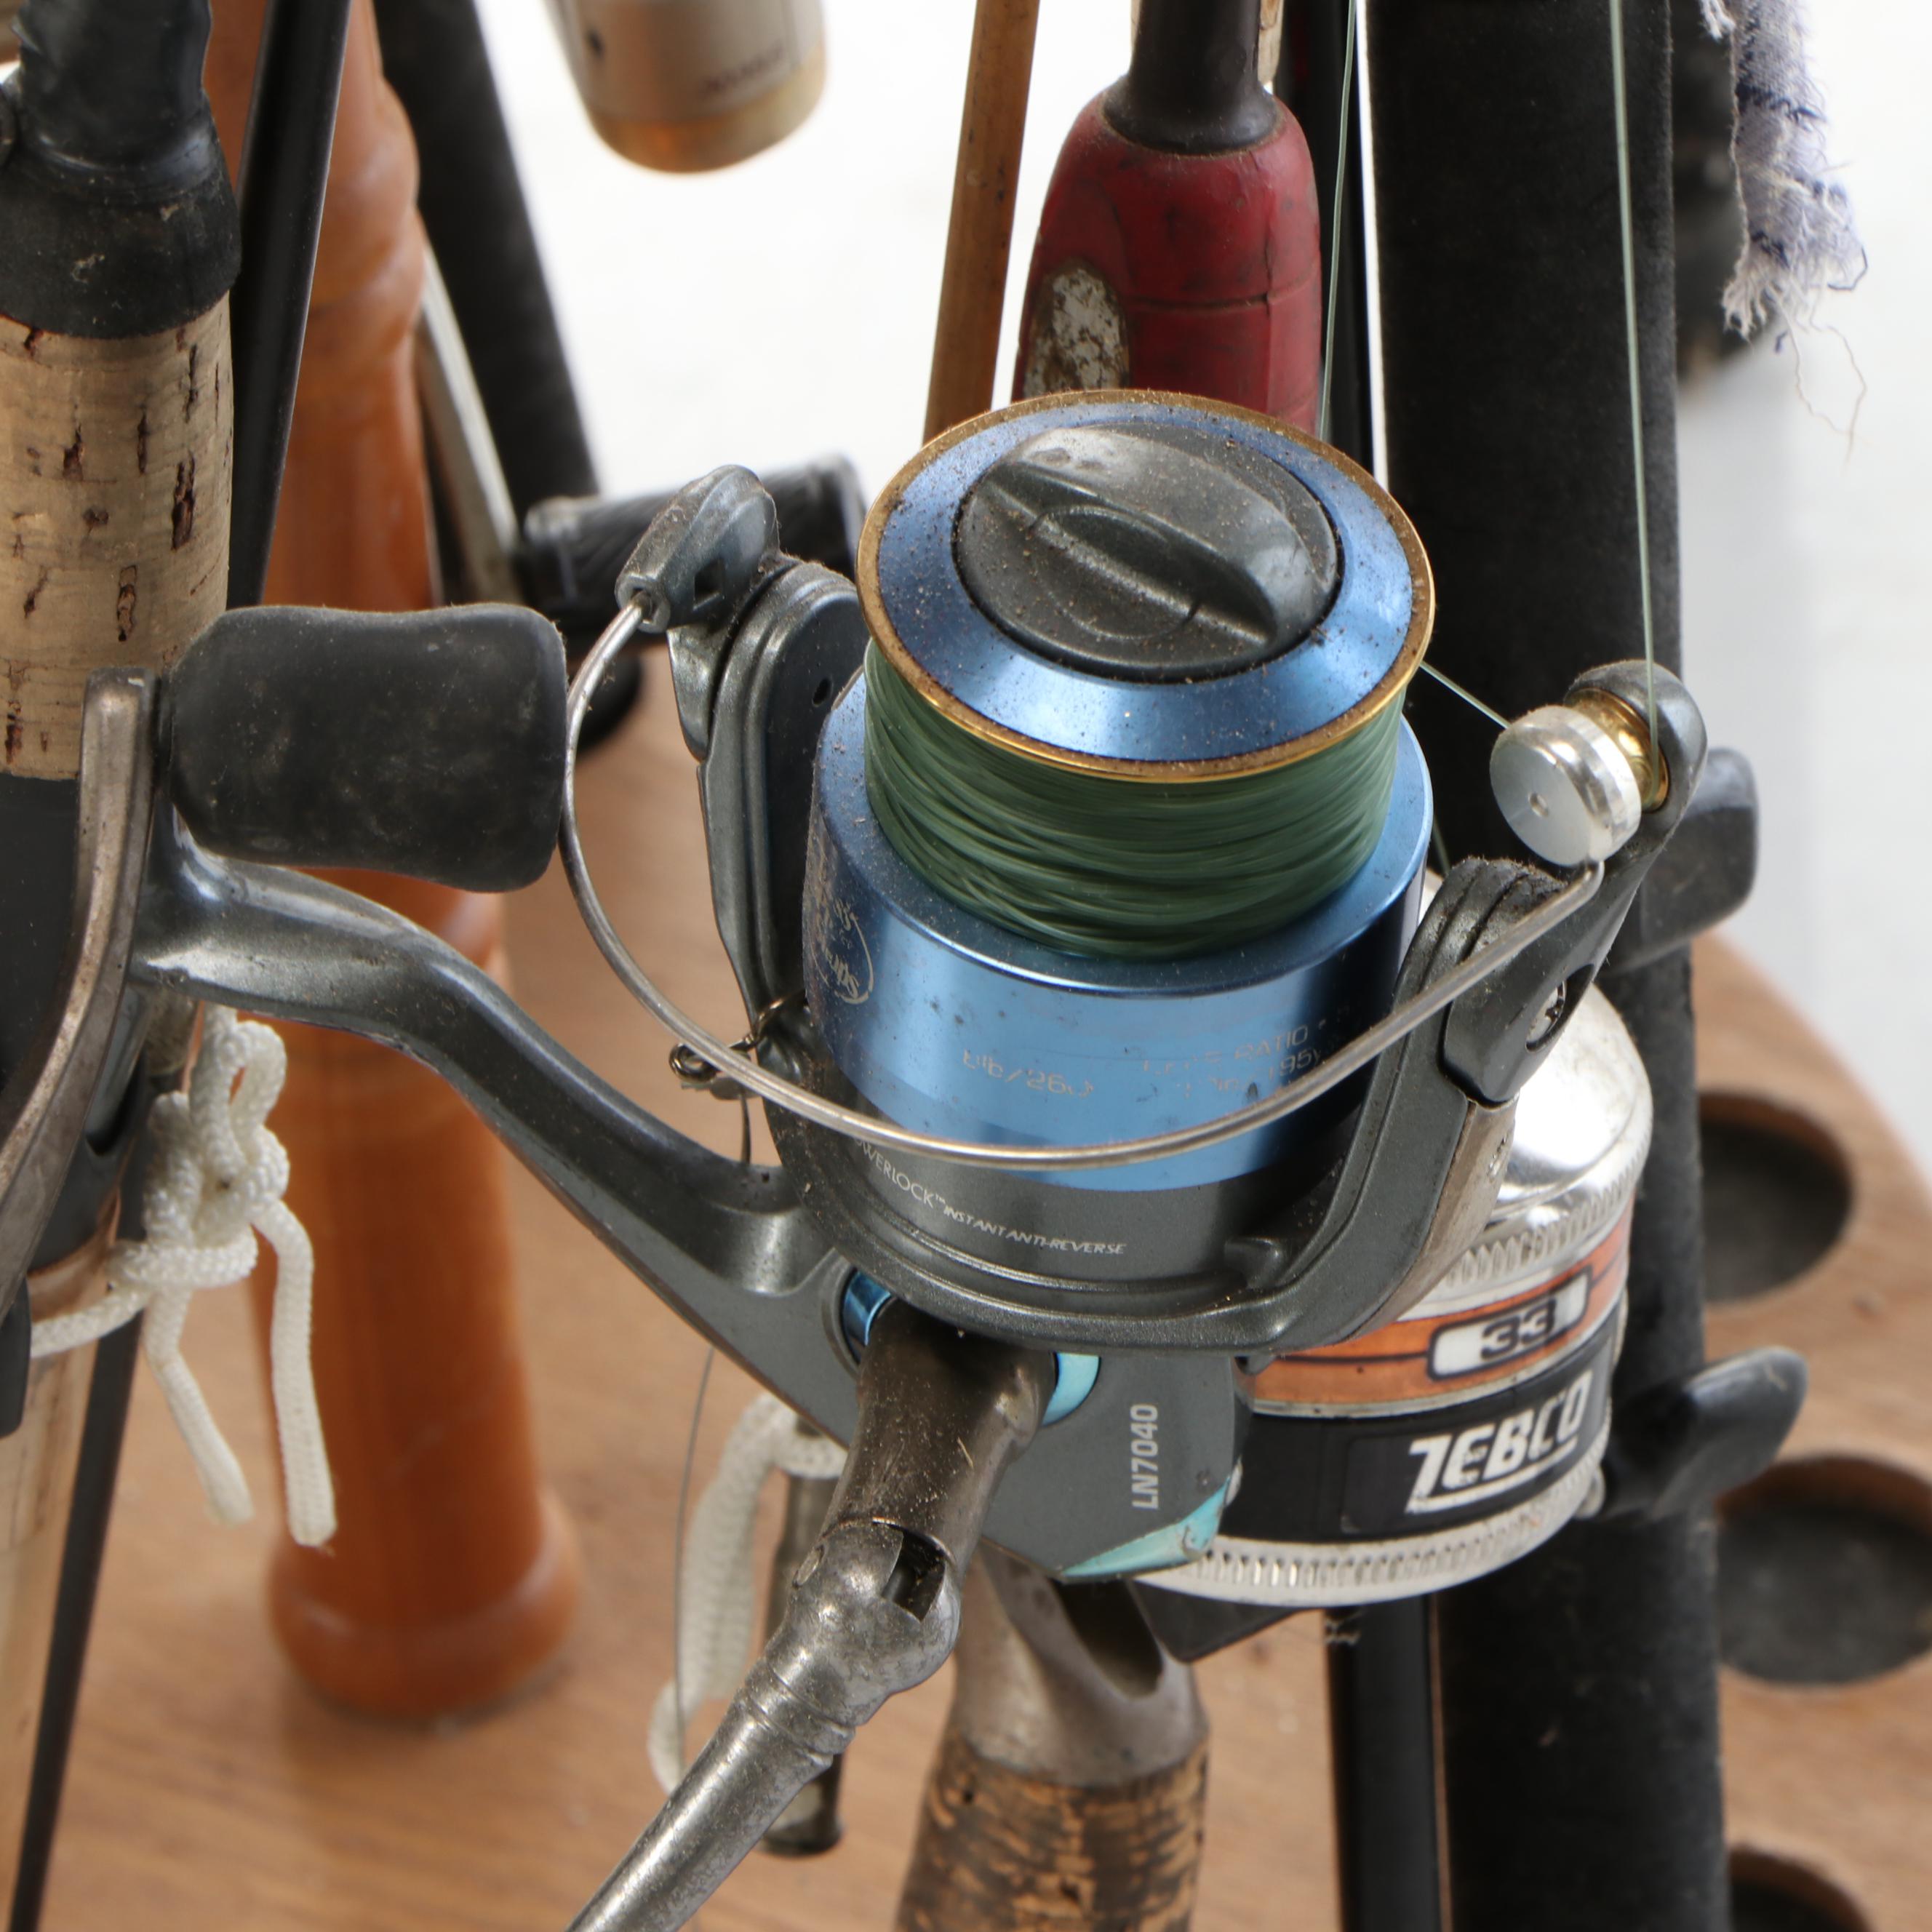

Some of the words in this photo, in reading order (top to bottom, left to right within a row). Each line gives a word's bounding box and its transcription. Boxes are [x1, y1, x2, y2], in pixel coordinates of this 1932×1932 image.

[943, 1205, 1007, 1237] INSTANT
[1479, 1298, 1557, 1362] 33
[1130, 1402, 1159, 1510] LN7040
[1404, 1368, 1594, 1514] ZEBCO
